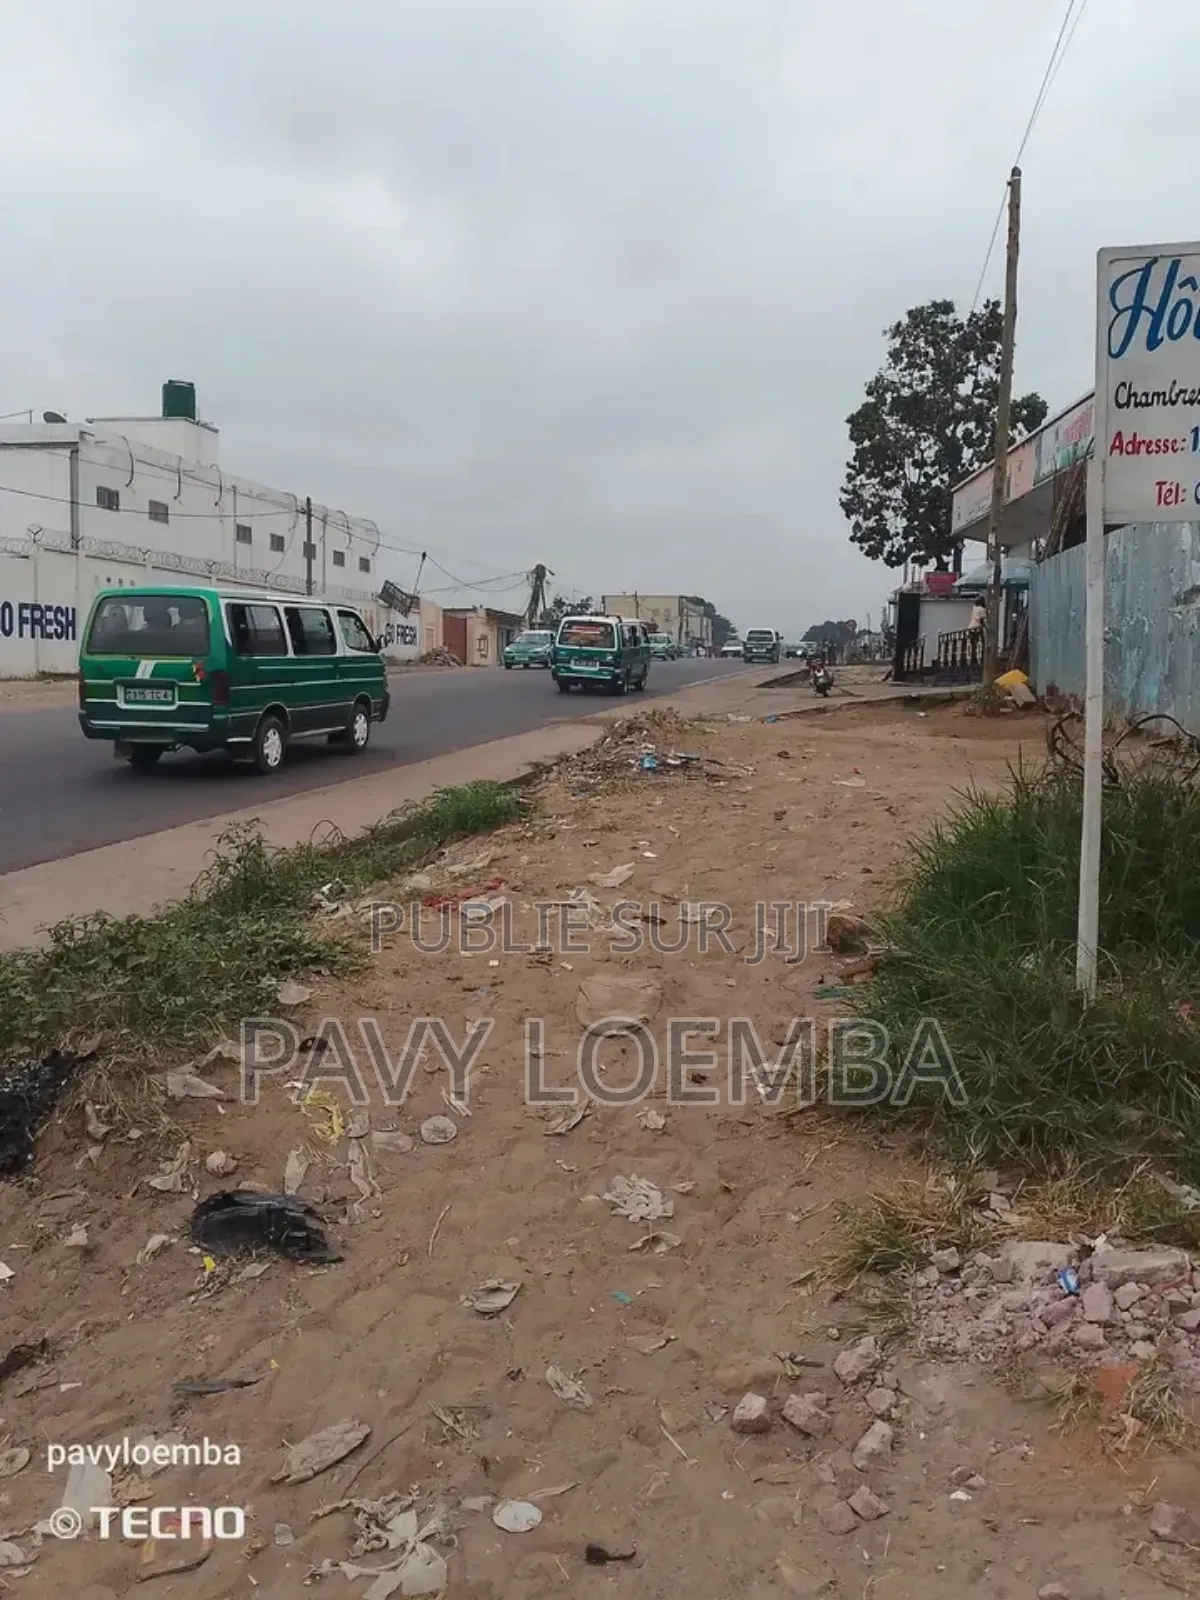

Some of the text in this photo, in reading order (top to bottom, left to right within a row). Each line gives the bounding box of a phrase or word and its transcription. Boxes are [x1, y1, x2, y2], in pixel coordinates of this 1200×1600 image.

[1108, 257, 1200, 358] Hô
[1108, 430, 1188, 456] Adresse:
[1155, 480, 1188, 507] Tél:
[0, 601, 76, 641] O FRESH
[396, 624, 418, 646] FRESH
